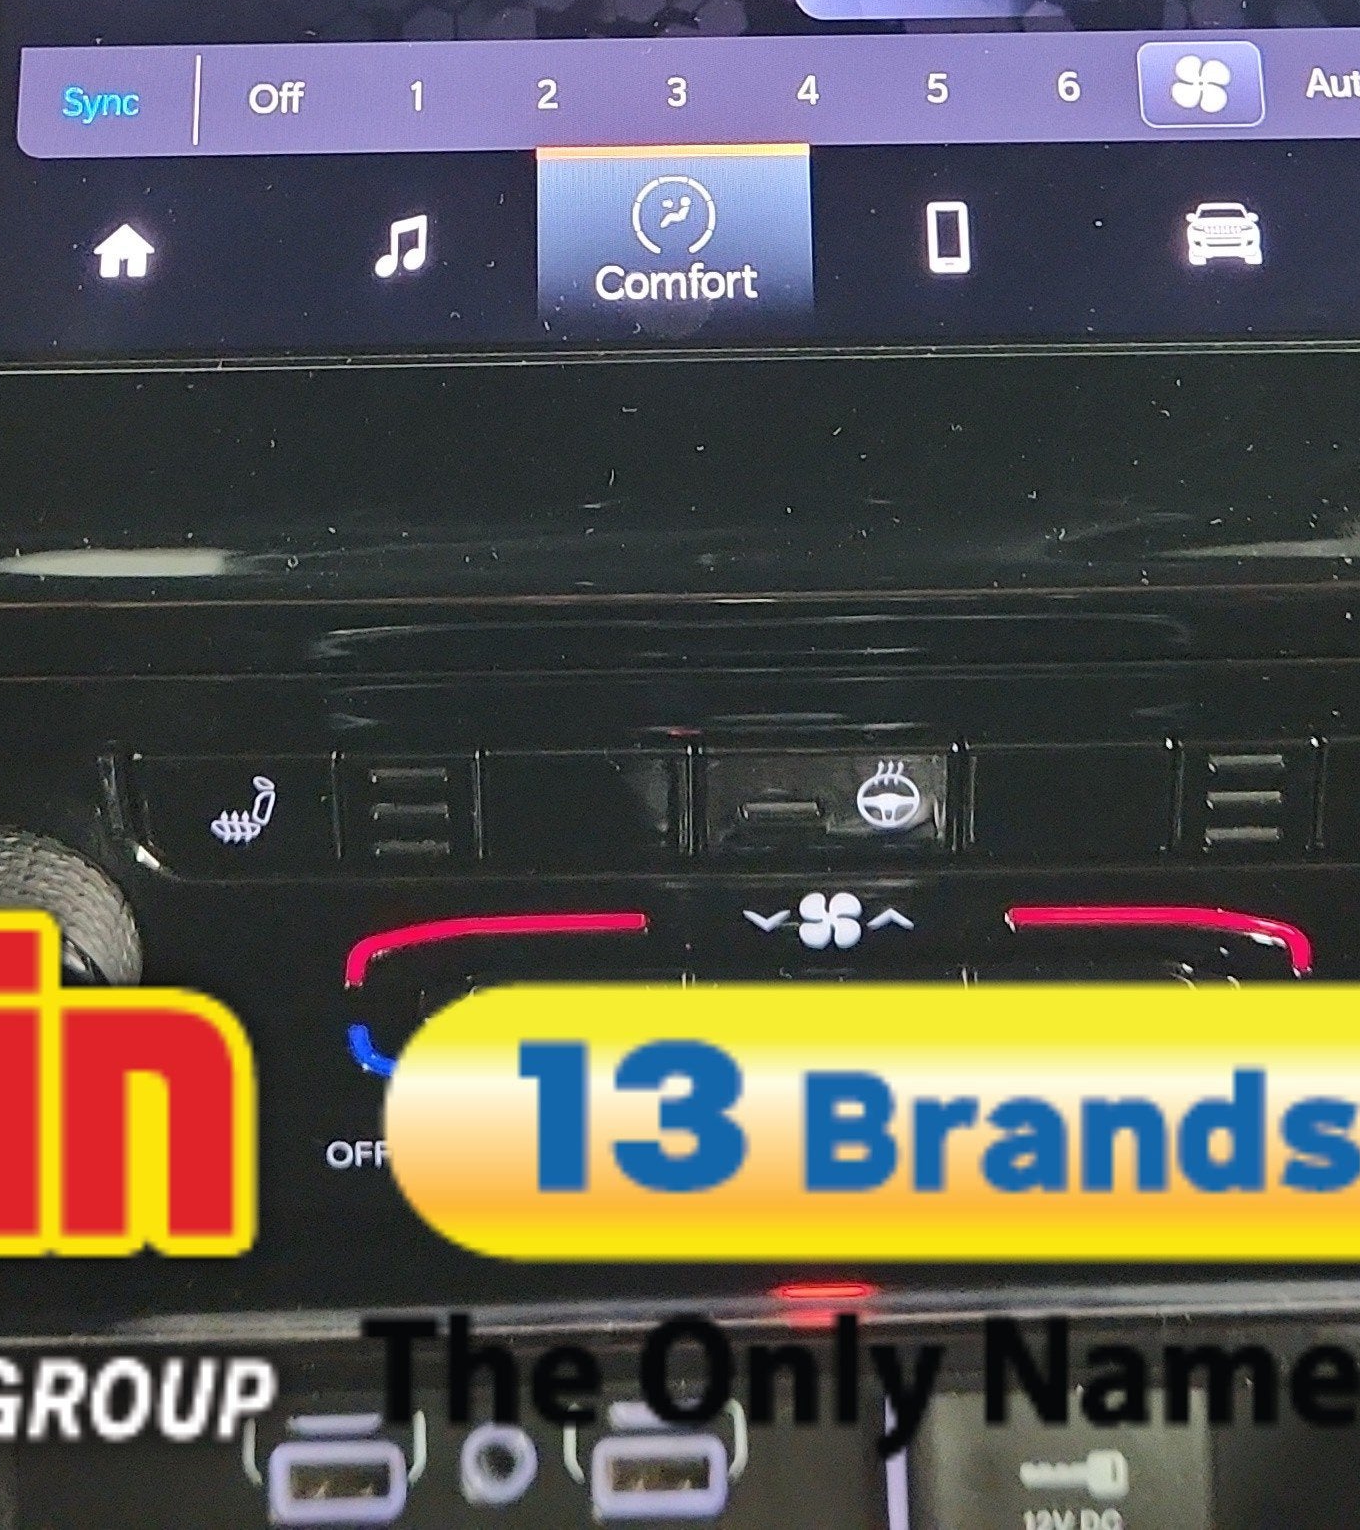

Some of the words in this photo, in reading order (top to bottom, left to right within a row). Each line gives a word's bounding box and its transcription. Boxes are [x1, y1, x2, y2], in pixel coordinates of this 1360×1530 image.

[62, 85, 140, 121] Sync
[249, 81, 305, 114] Off
[411, 81, 422, 111] 1
[537, 79, 558, 109] 2
[667, 77, 687, 107] 3
[797, 75, 819, 105] 4
[927, 73, 948, 103] 5
[1058, 71, 1081, 102] 6
[595, 262, 758, 301] Comfort
[326, 1139, 392, 1169] OFF
